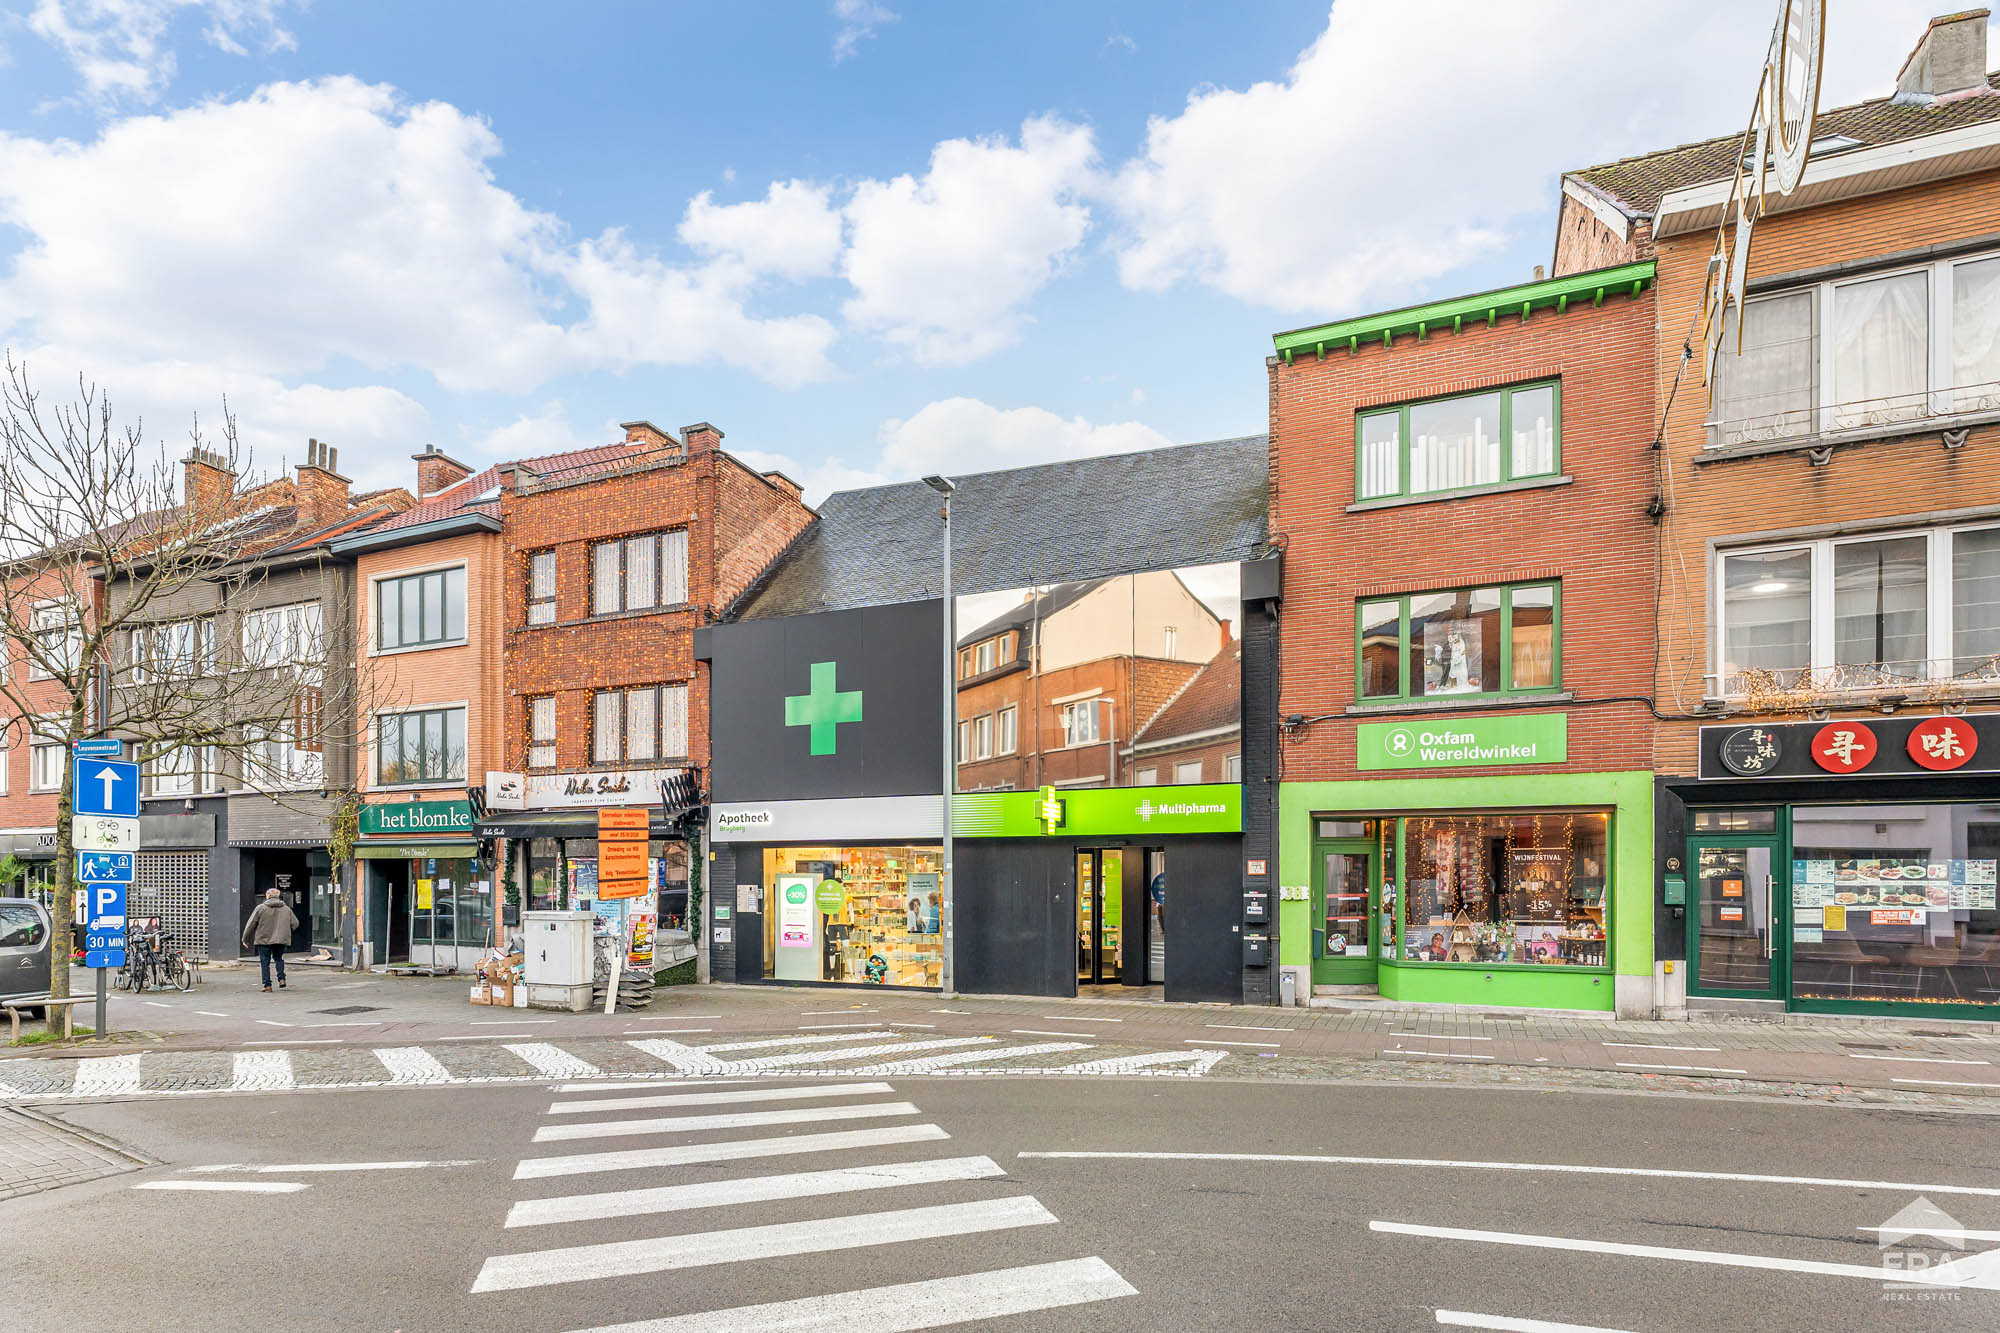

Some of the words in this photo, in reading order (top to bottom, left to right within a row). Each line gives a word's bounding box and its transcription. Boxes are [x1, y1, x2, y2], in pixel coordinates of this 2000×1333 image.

[1420, 731, 1475, 746] Oxfam
[1420, 743, 1536, 761] Wereldwinkel
[1823, 731, 1865, 766] 寻
[1920, 727, 1965, 760] 味
[597, 774, 631, 795] Sushi
[1159, 803, 1226, 816] Multipharma
[380, 809, 405, 828] het
[408, 807, 469, 828] blomke
[719, 813, 769, 825] Apotheek
[1284, 886, 1302, 901] 38
[97, 888, 118, 915] P
[1526, 899, 1552, 910] -15%
[89, 936, 105, 948] 30
[108, 937, 124, 948] MIN
